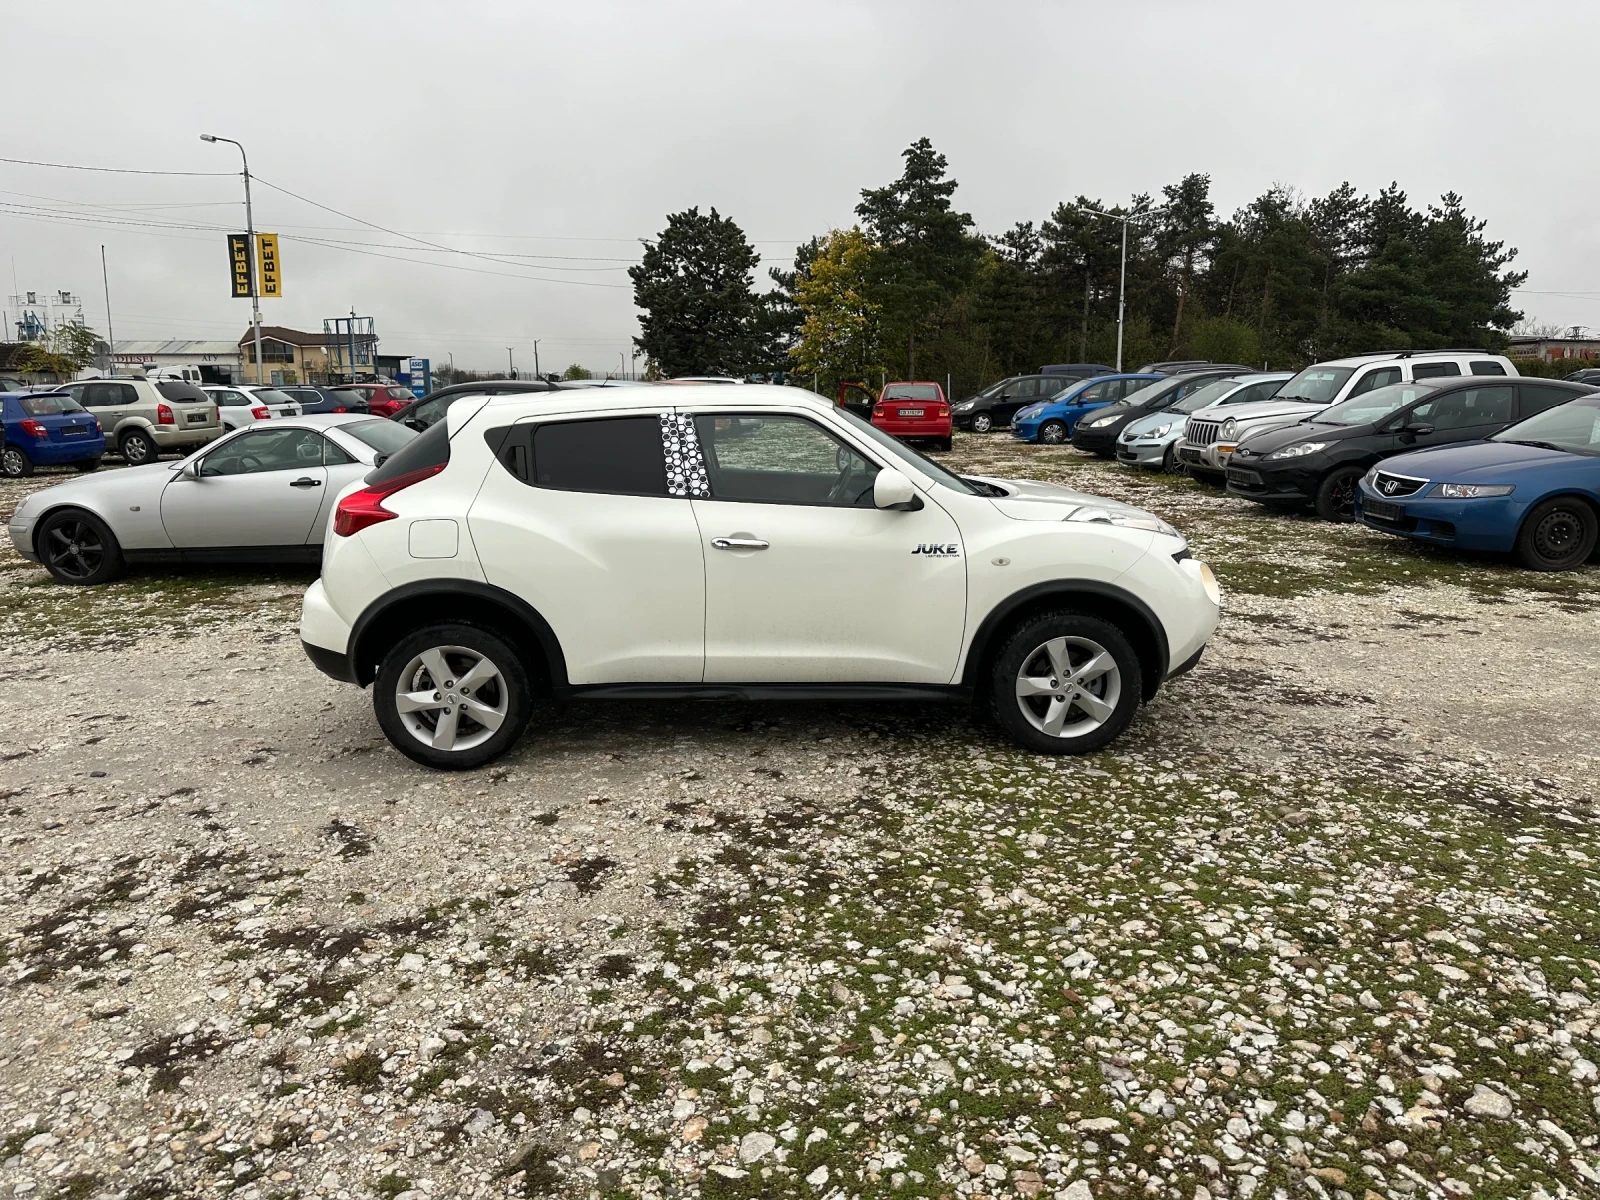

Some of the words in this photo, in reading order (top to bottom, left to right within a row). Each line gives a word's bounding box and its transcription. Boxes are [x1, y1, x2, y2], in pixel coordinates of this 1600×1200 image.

[232, 238, 248, 294] EFBET
[261, 238, 277, 294] EFBET
[115, 355, 157, 363] DIESEL
[911, 543, 959, 555] JUKE
